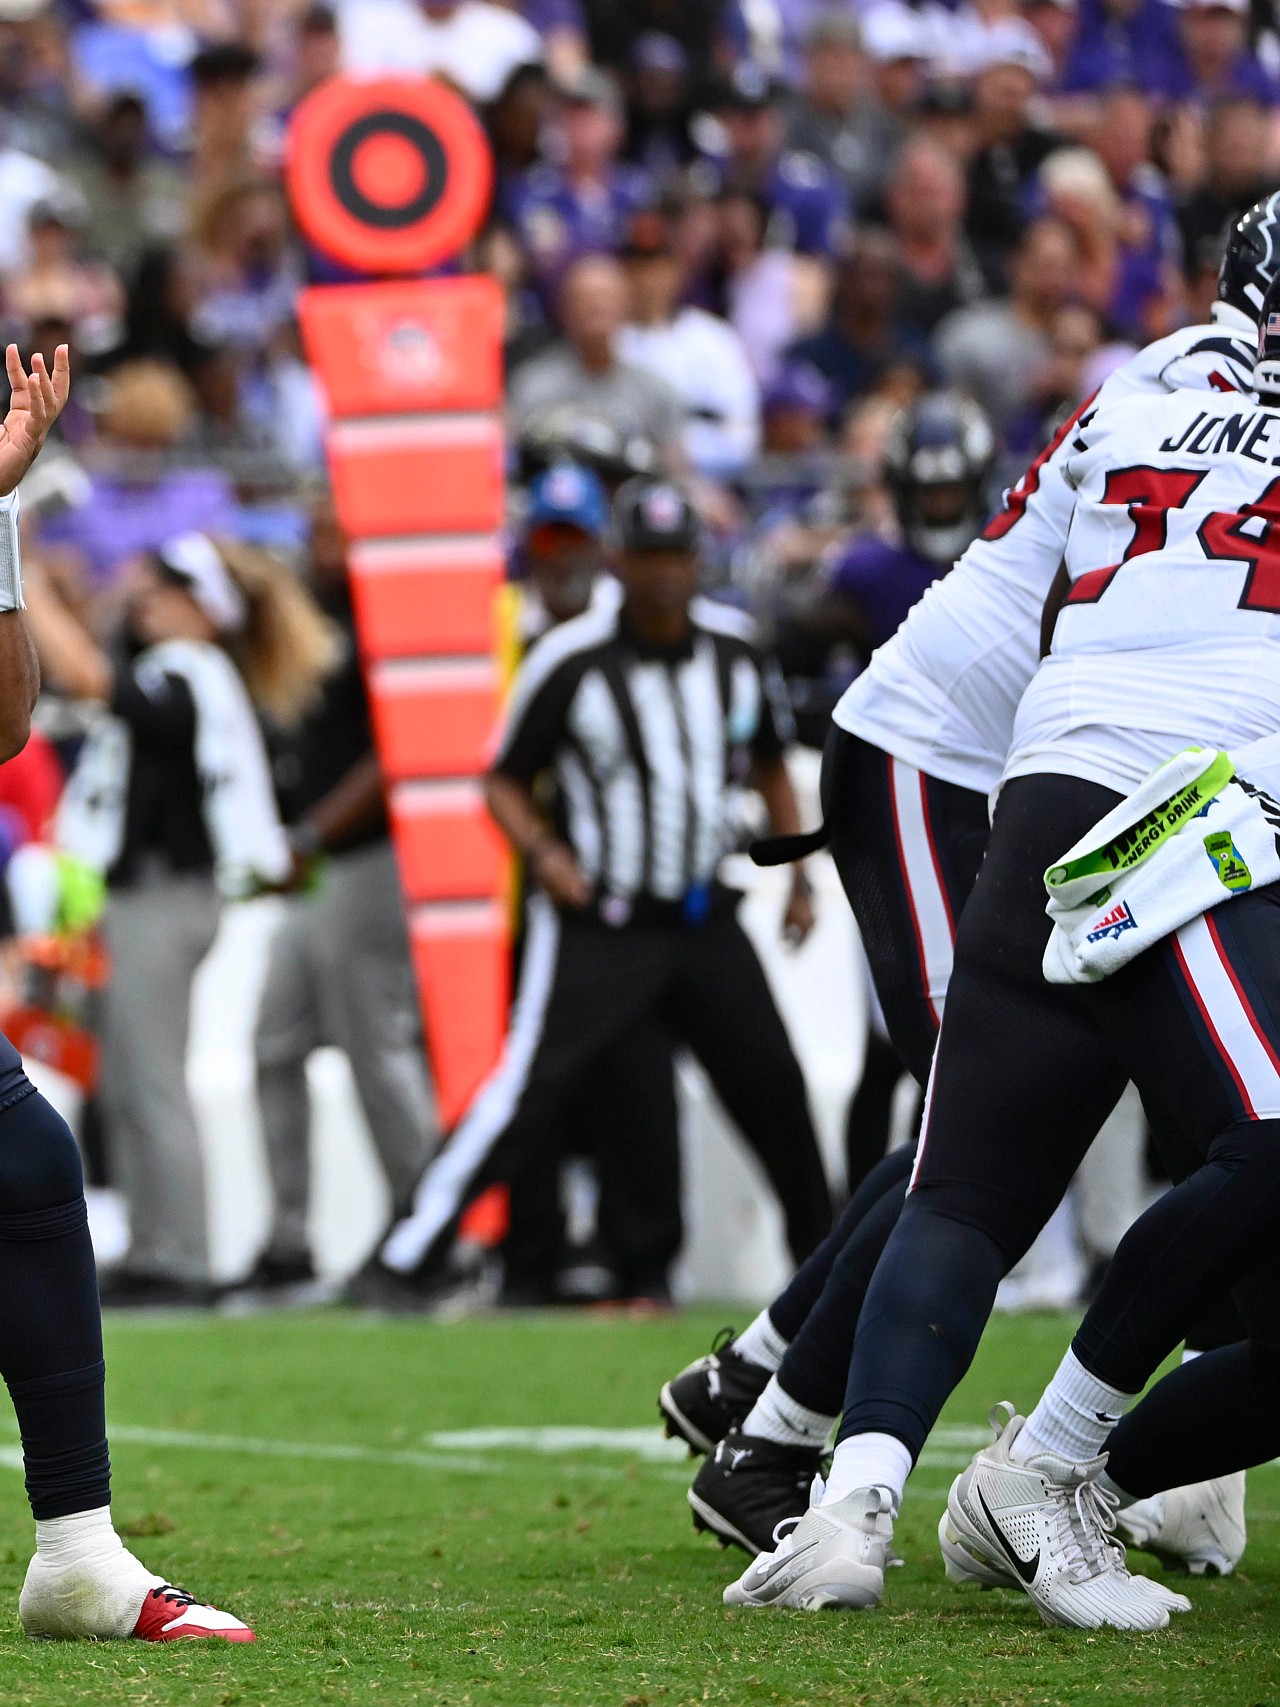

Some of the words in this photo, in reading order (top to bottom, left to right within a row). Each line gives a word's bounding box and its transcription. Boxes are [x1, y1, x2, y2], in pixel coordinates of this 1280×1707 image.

[1159, 411, 1280, 468] JONE
[1121, 821, 1166, 868] ENERGY
[1166, 786, 1203, 825] DRINK
